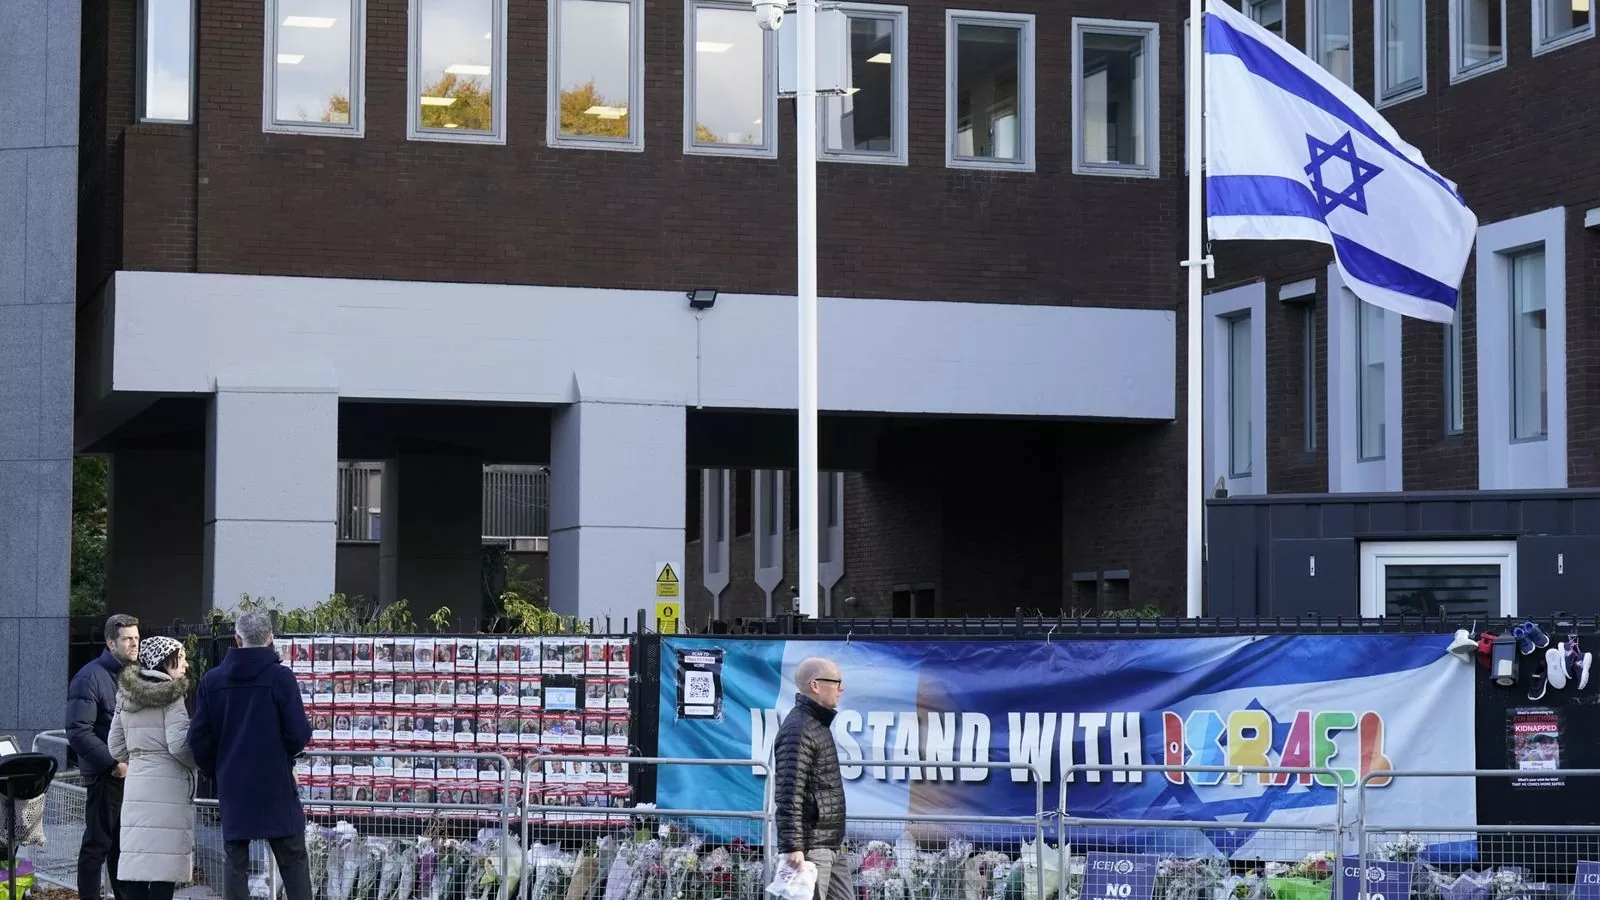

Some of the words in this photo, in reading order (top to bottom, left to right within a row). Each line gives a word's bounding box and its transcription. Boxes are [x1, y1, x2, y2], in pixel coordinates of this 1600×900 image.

[835, 709, 991, 782] STAND
[1008, 711, 1143, 783] WITH
[1162, 709, 1394, 788] ISRAEL
[1092, 860, 1114, 872] ICEJ
[1106, 883, 1132, 898] NO
